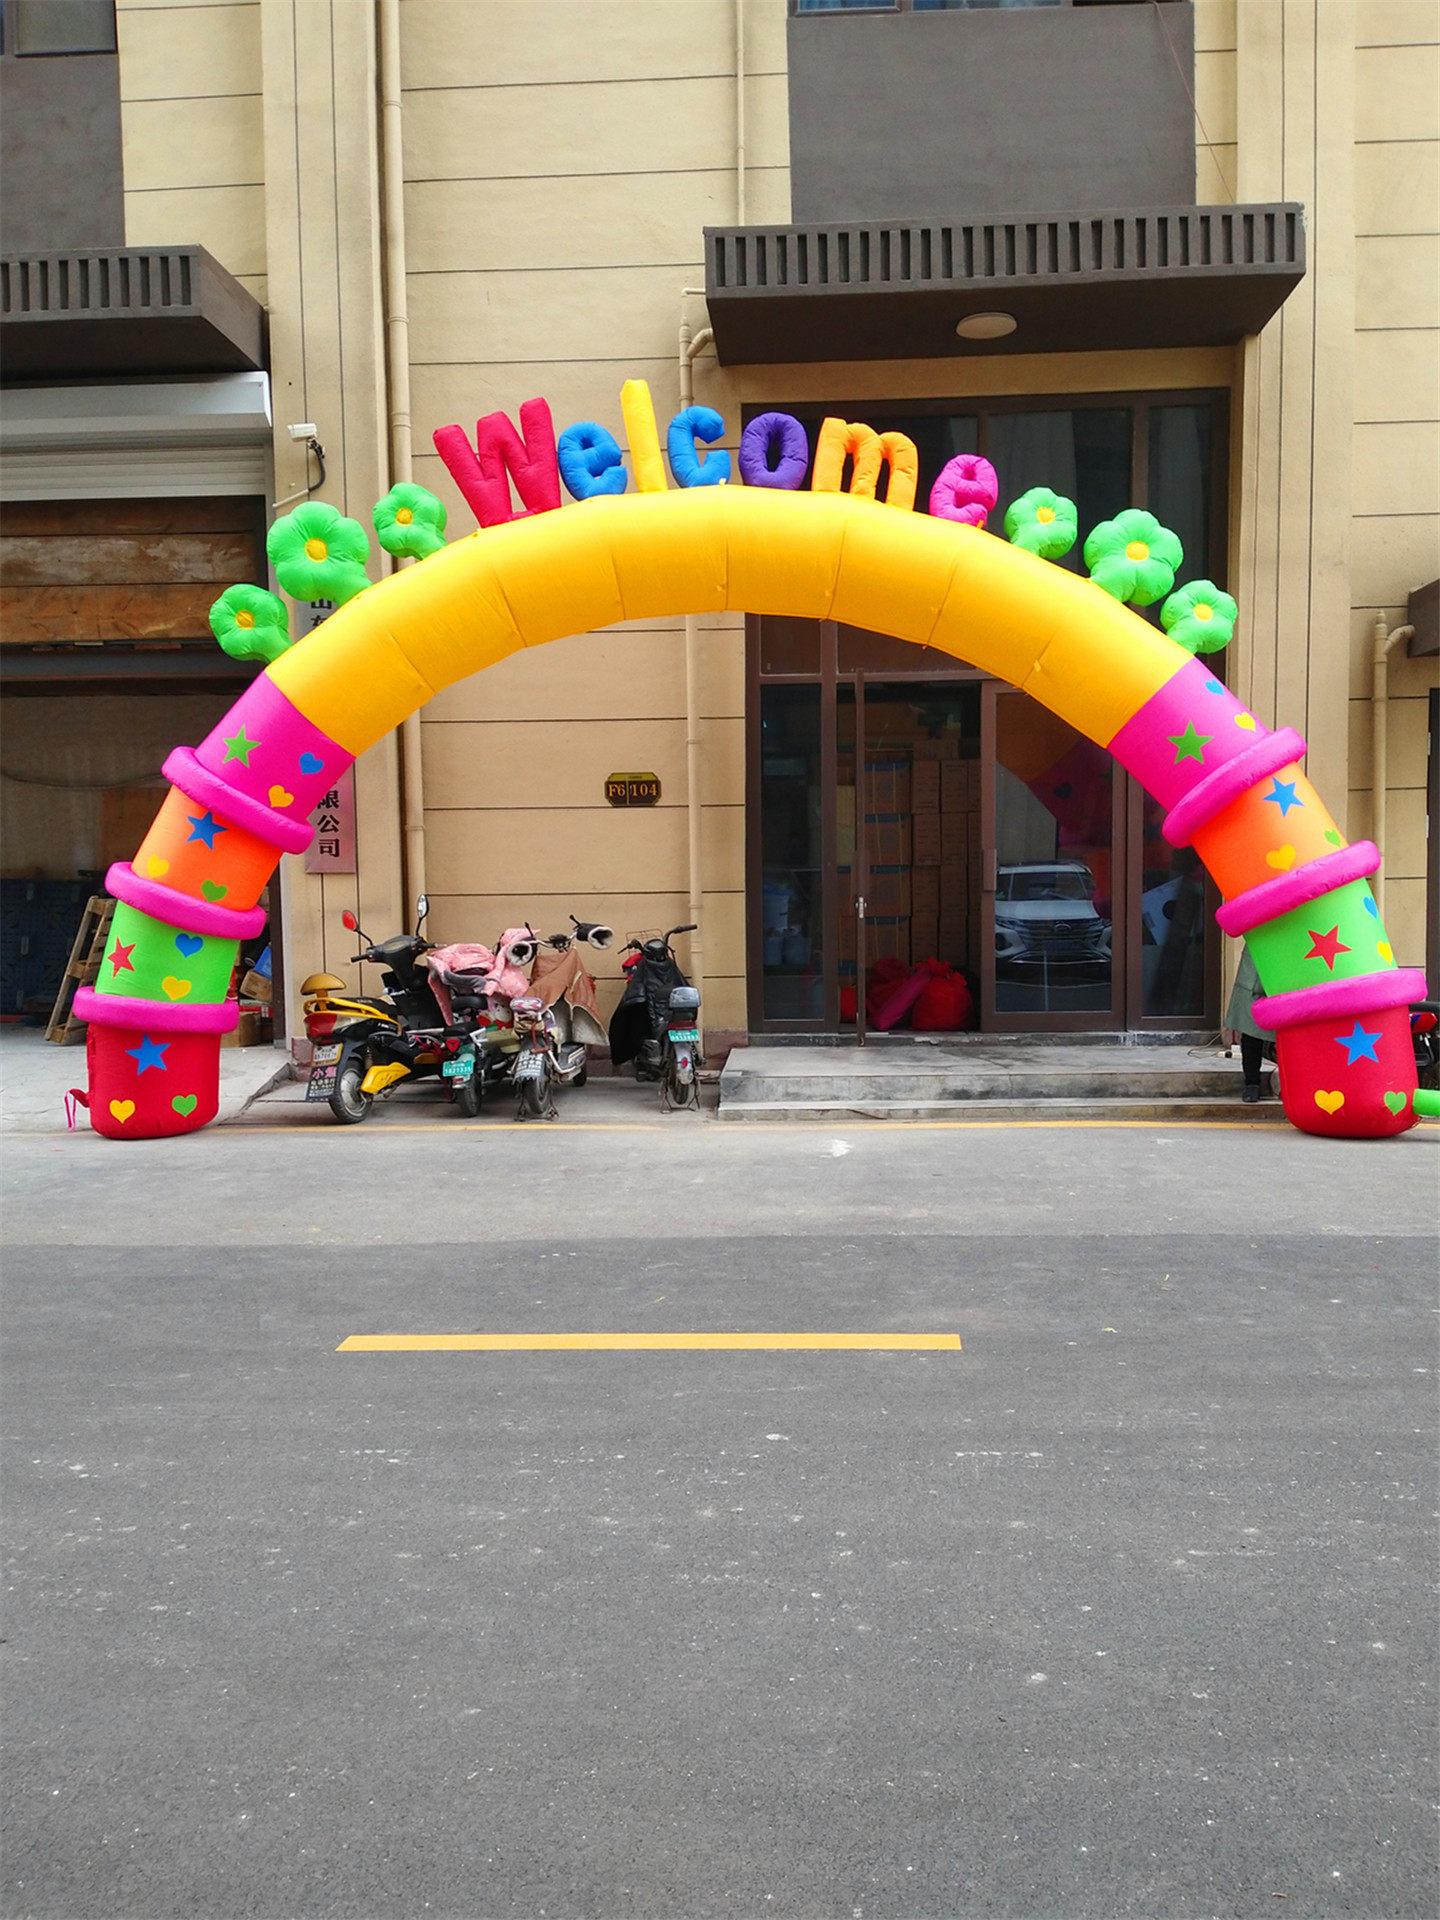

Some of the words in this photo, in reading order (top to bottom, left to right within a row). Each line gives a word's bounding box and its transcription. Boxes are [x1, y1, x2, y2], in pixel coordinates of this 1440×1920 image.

[433, 379, 998, 527] Welcome
[608, 783, 626, 797] F6
[631, 783, 657, 797] 104
